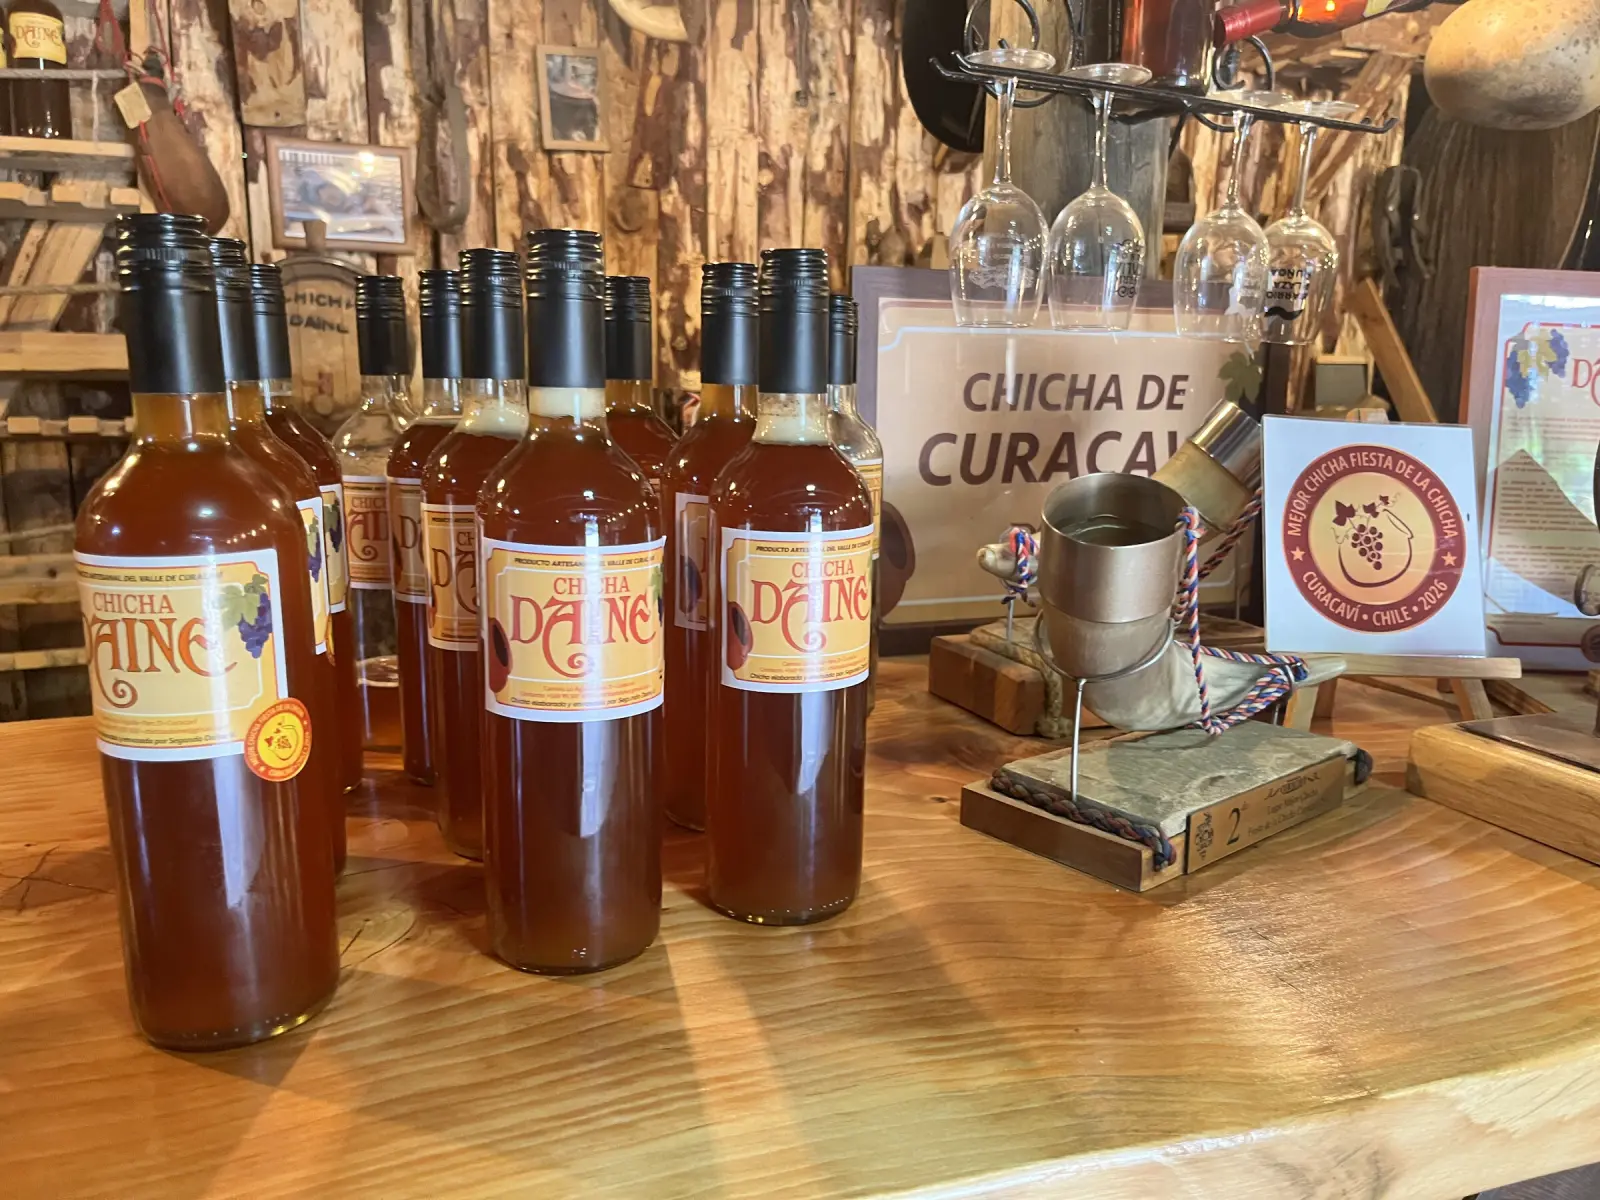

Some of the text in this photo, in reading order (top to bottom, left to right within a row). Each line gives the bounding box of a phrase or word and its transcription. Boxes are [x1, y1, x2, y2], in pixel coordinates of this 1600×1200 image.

[963, 371, 1190, 412] CHICHA DE
[918, 430, 1180, 487] CURACA
[1288, 451, 1459, 539] MEJOR CHICHA FIESTA DE LA CHICHA
[139, 574, 164, 583] VALLE
[165, 573, 178, 582] DE
[553, 576, 630, 595] CHHA
[792, 558, 855, 578] CHCHA
[92, 591, 175, 614] CHICHA
[1302, 570, 1449, 627] CURACAVÍ CHILE 2026
[510, 592, 656, 678] DANE
[82, 613, 238, 708] AINE
